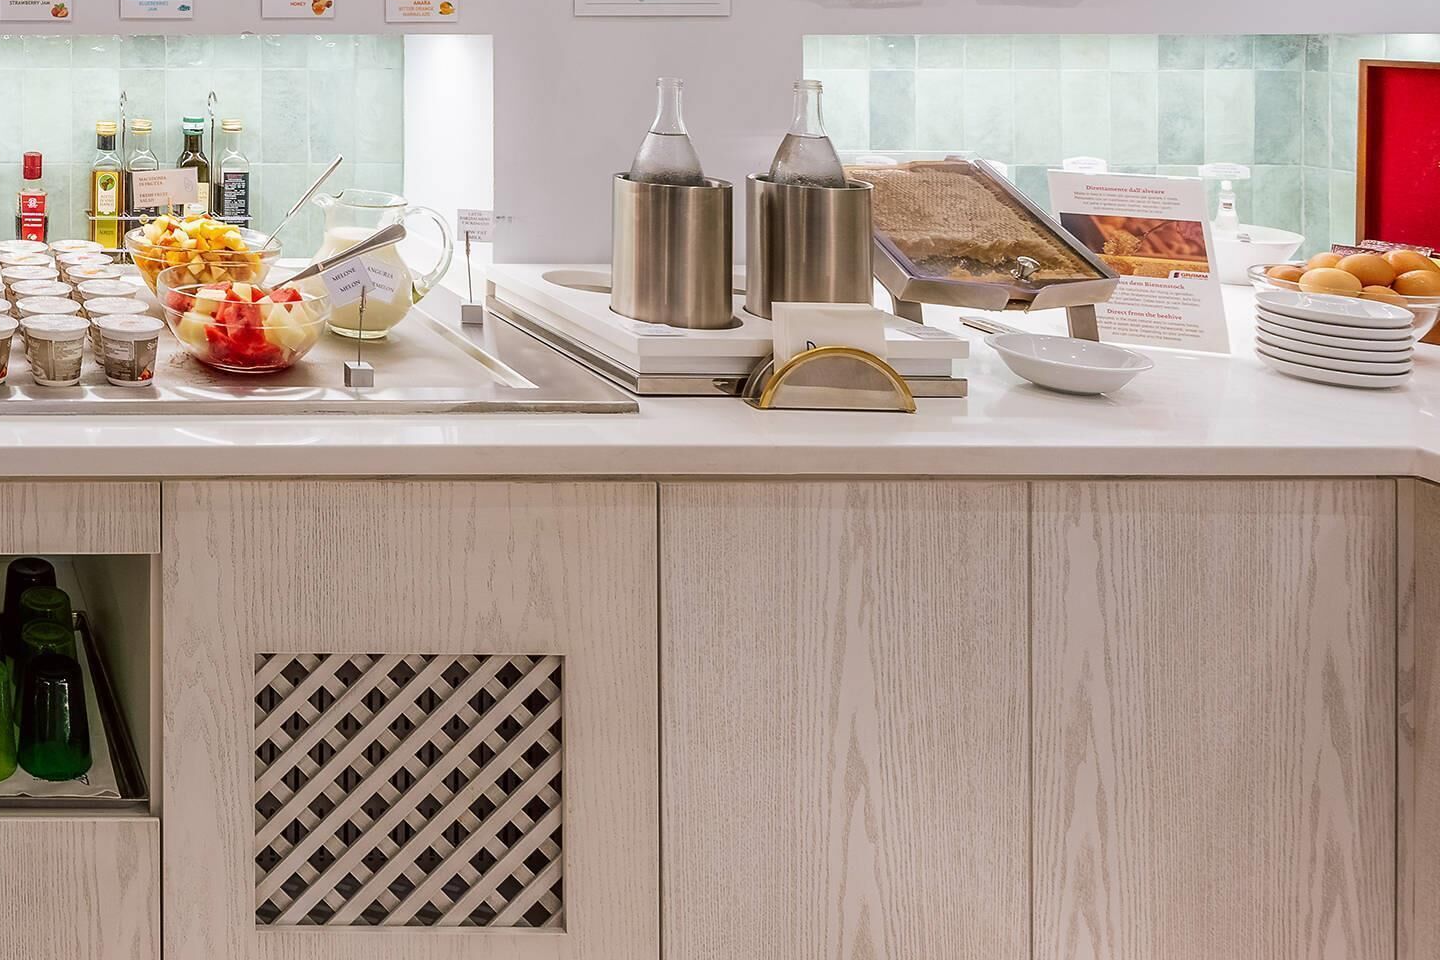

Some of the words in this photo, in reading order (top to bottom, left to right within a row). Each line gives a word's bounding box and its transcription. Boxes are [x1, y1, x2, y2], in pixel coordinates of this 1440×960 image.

[1086, 185, 1128, 193] Direttamente
[332, 267, 356, 282] MELONE
[368, 267, 393, 279] ANGURIA
[339, 280, 361, 293] MELON
[1145, 282, 1185, 290] Bienenstock
[1157, 313, 1182, 321] beehive
